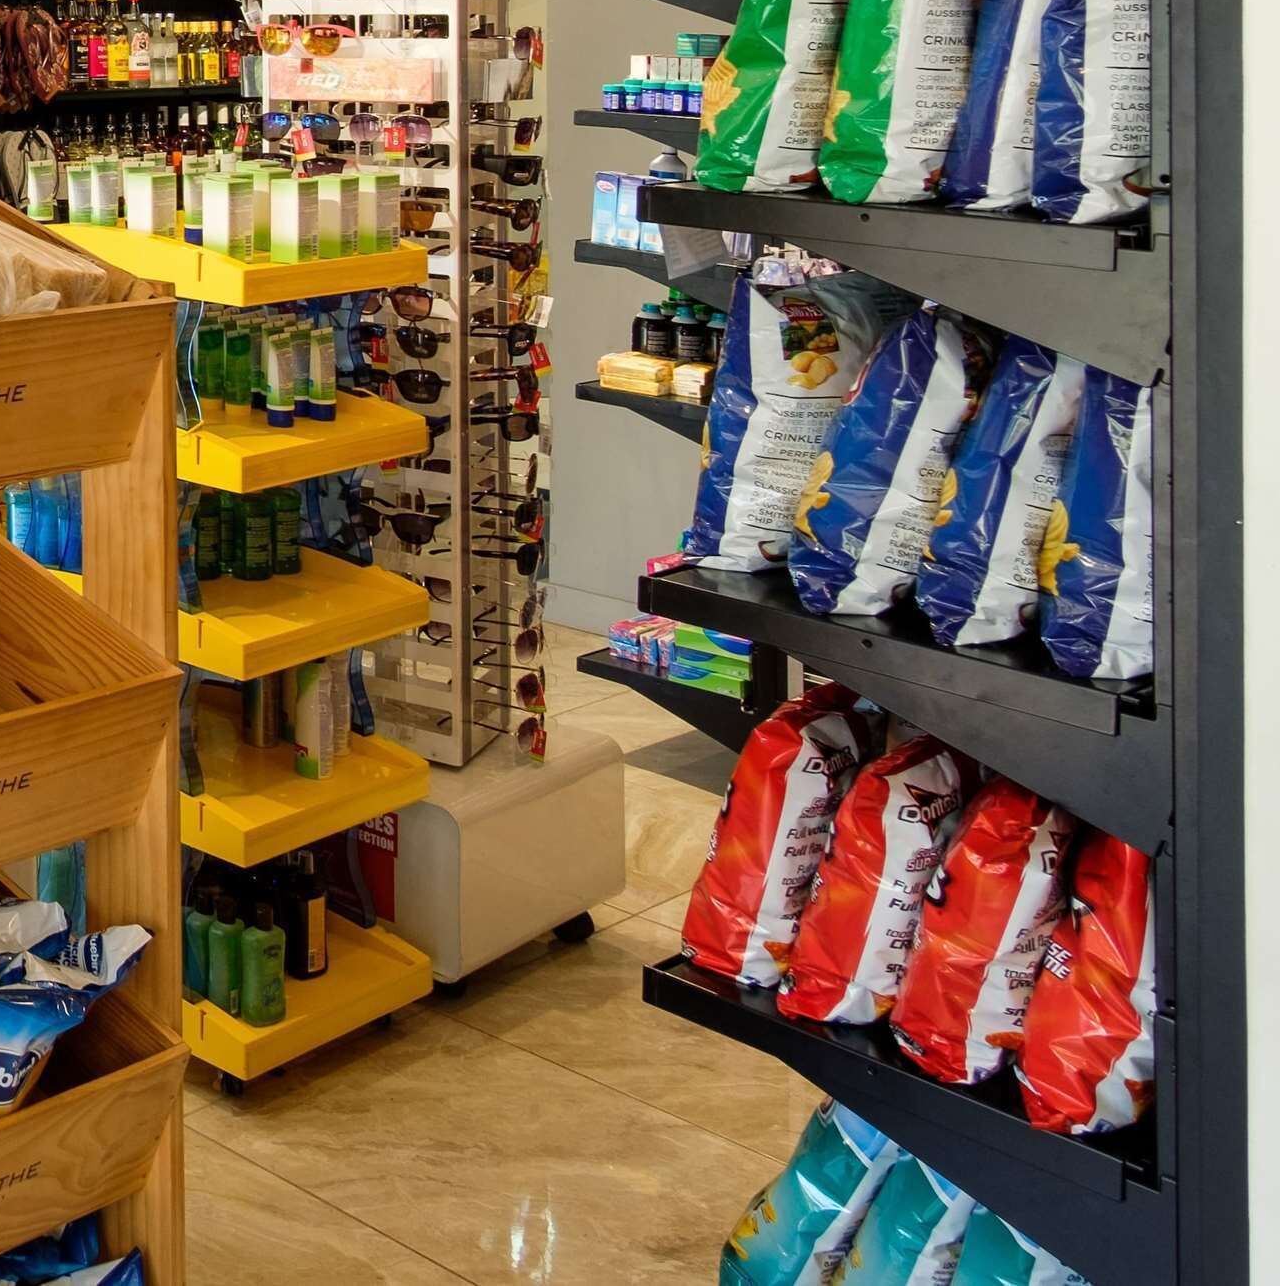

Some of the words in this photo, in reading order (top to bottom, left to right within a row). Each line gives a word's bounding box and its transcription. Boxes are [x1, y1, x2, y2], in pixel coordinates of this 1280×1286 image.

[1113, 52, 1132, 62] TO
[915, 100, 960, 110] CLASSIC
[785, 136, 808, 145] CHIP
[910, 136, 938, 145] CHIP
[1109, 143, 1140, 153] CHIP
[764, 429, 823, 445] CRINKLE
[754, 481, 799, 497] CLASSIC
[747, 514, 773, 526] CHIP
[787, 827, 807, 840] Full
[355, 831, 394, 852] ECTION
[783, 847, 807, 858] Full
[891, 879, 920, 895] Full
[888, 898, 918, 912] Full
